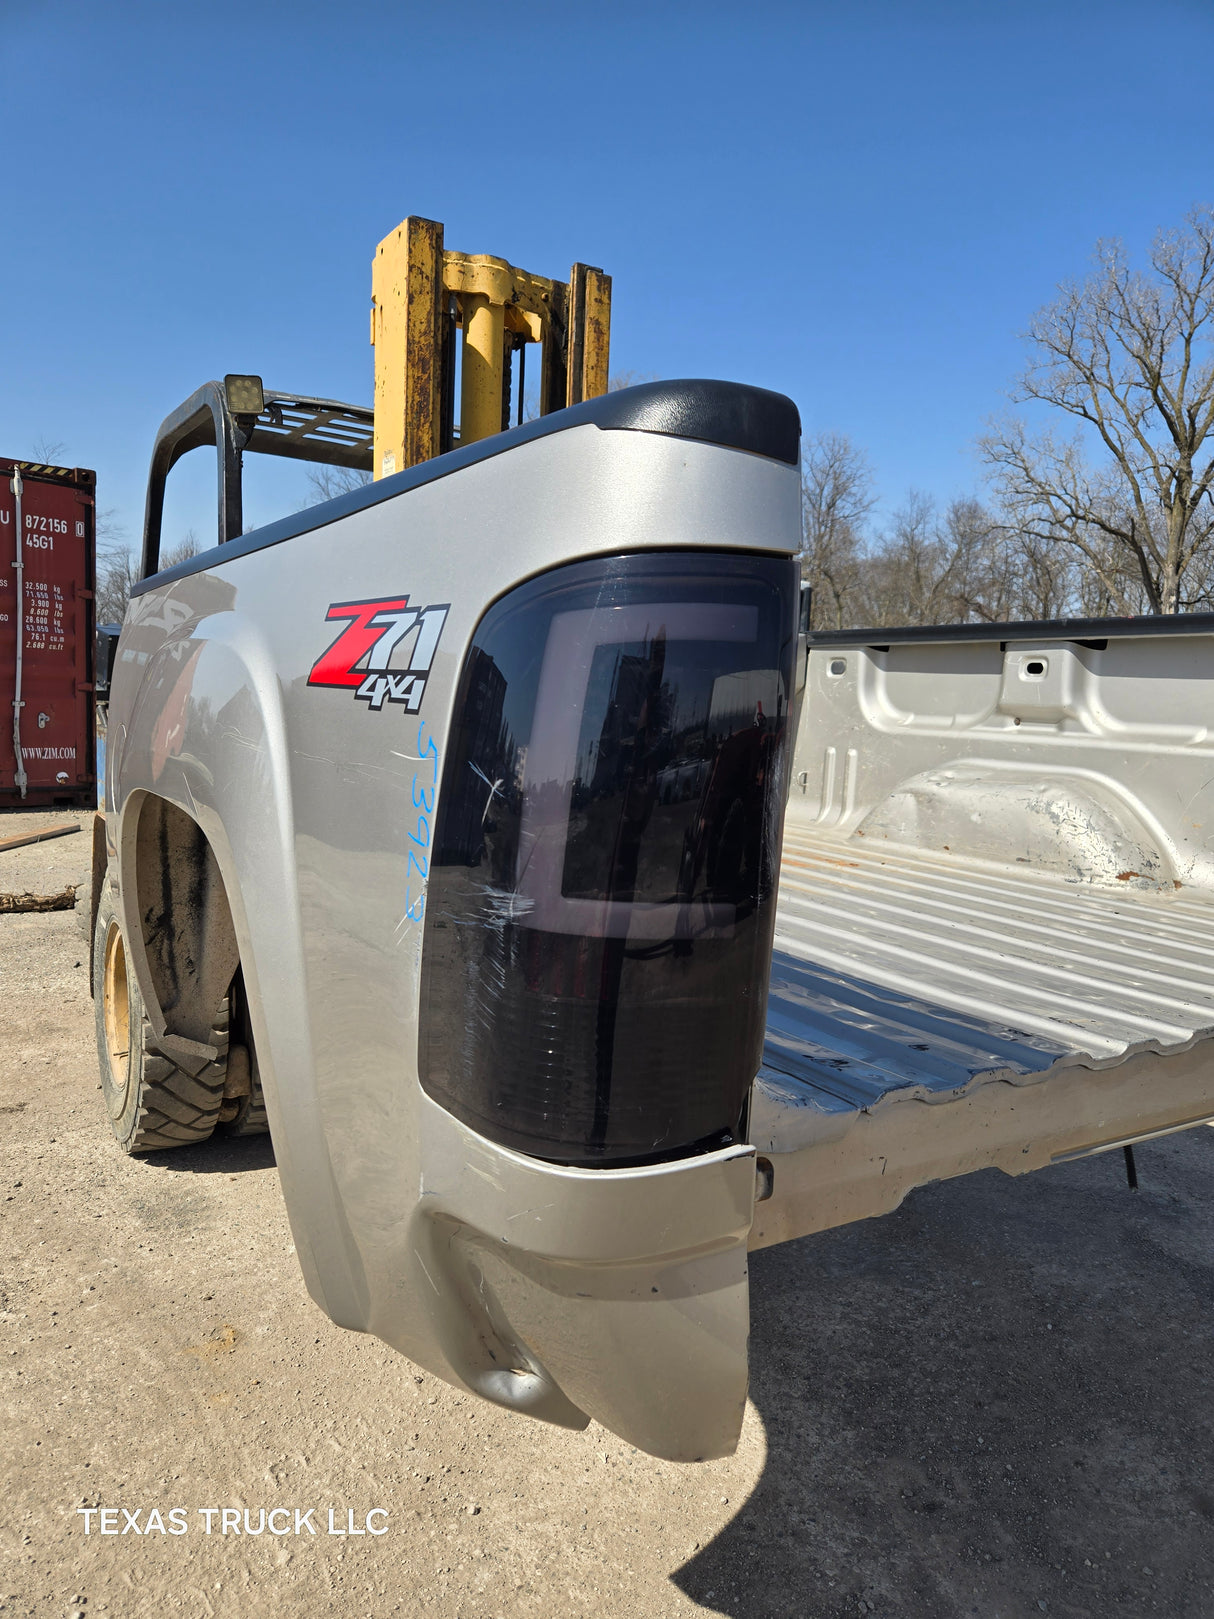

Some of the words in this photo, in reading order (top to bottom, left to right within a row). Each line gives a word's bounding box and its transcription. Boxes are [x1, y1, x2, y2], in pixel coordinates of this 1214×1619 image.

[25, 514, 68, 534] 872156
[25, 534, 54, 550] 45G1
[25, 581, 48, 591] 32.500
[53, 585, 61, 594] kg
[31, 599, 50, 608] 3.900
[55, 601, 62, 611] kg
[25, 615, 48, 625] 28.600
[53, 618, 61, 628] kg
[307, 594, 451, 690] Z71
[21, 747, 76, 760] WWW.ZIM.COM
